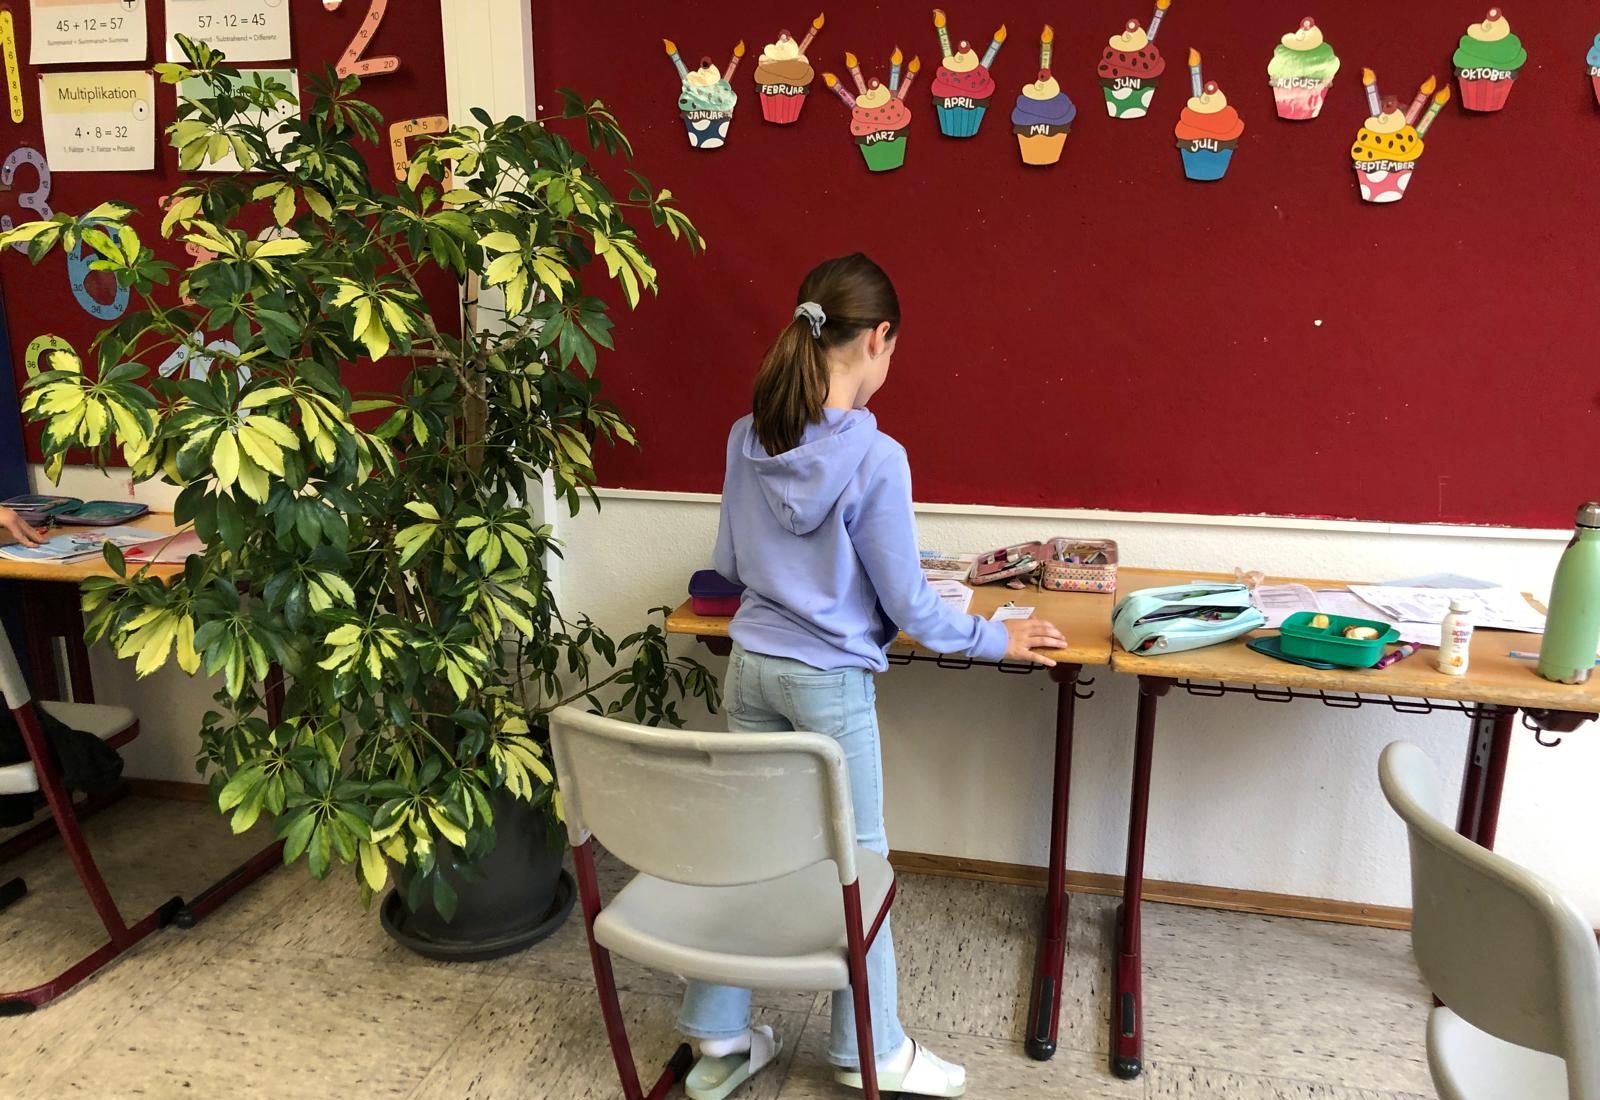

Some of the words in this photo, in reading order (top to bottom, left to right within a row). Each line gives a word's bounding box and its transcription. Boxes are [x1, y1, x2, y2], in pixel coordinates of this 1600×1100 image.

[198, 15, 212, 28] 57
[223, 14, 237, 27] 12
[251, 13, 266, 26] 45
[371, 11, 380, 21] 10
[56, 20, 70, 32] 45
[83, 18, 97, 31] 12
[110, 17, 123, 30] 57
[360, 30, 368, 38] 12
[8, 51, 14, 60] 6
[383, 60, 394, 69] 20
[10, 66, 15, 74] 7
[1460, 67, 1512, 81] OKTOBER
[12, 81, 17, 89] 8
[1113, 76, 1141, 90] JUNI
[1276, 76, 1321, 90] AUGUST
[58, 86, 137, 103] Multiplikation
[761, 84, 804, 96] FEBRUAR
[13, 95, 18, 103] 9
[943, 96, 975, 110] APRIL
[13, 108, 21, 117] 10
[687, 110, 723, 120] JANUAR
[404, 125, 413, 133] 10
[422, 121, 428, 130] 5
[1030, 124, 1050, 136] MAI
[75, 127, 82, 139] 4
[95, 126, 102, 138] 8
[115, 126, 128, 138] 32
[394, 138, 402, 148] 15
[1190, 139, 1219, 152] JULI
[27, 151, 32, 160] 6
[396, 161, 407, 170] 20
[1354, 160, 1415, 172] SEPTEMBER
[69, 251, 79, 261] 24
[73, 284, 84, 293] 30
[30, 342, 40, 351] 27
[175, 350, 185, 360] 10
[27, 360, 36, 369] 36
